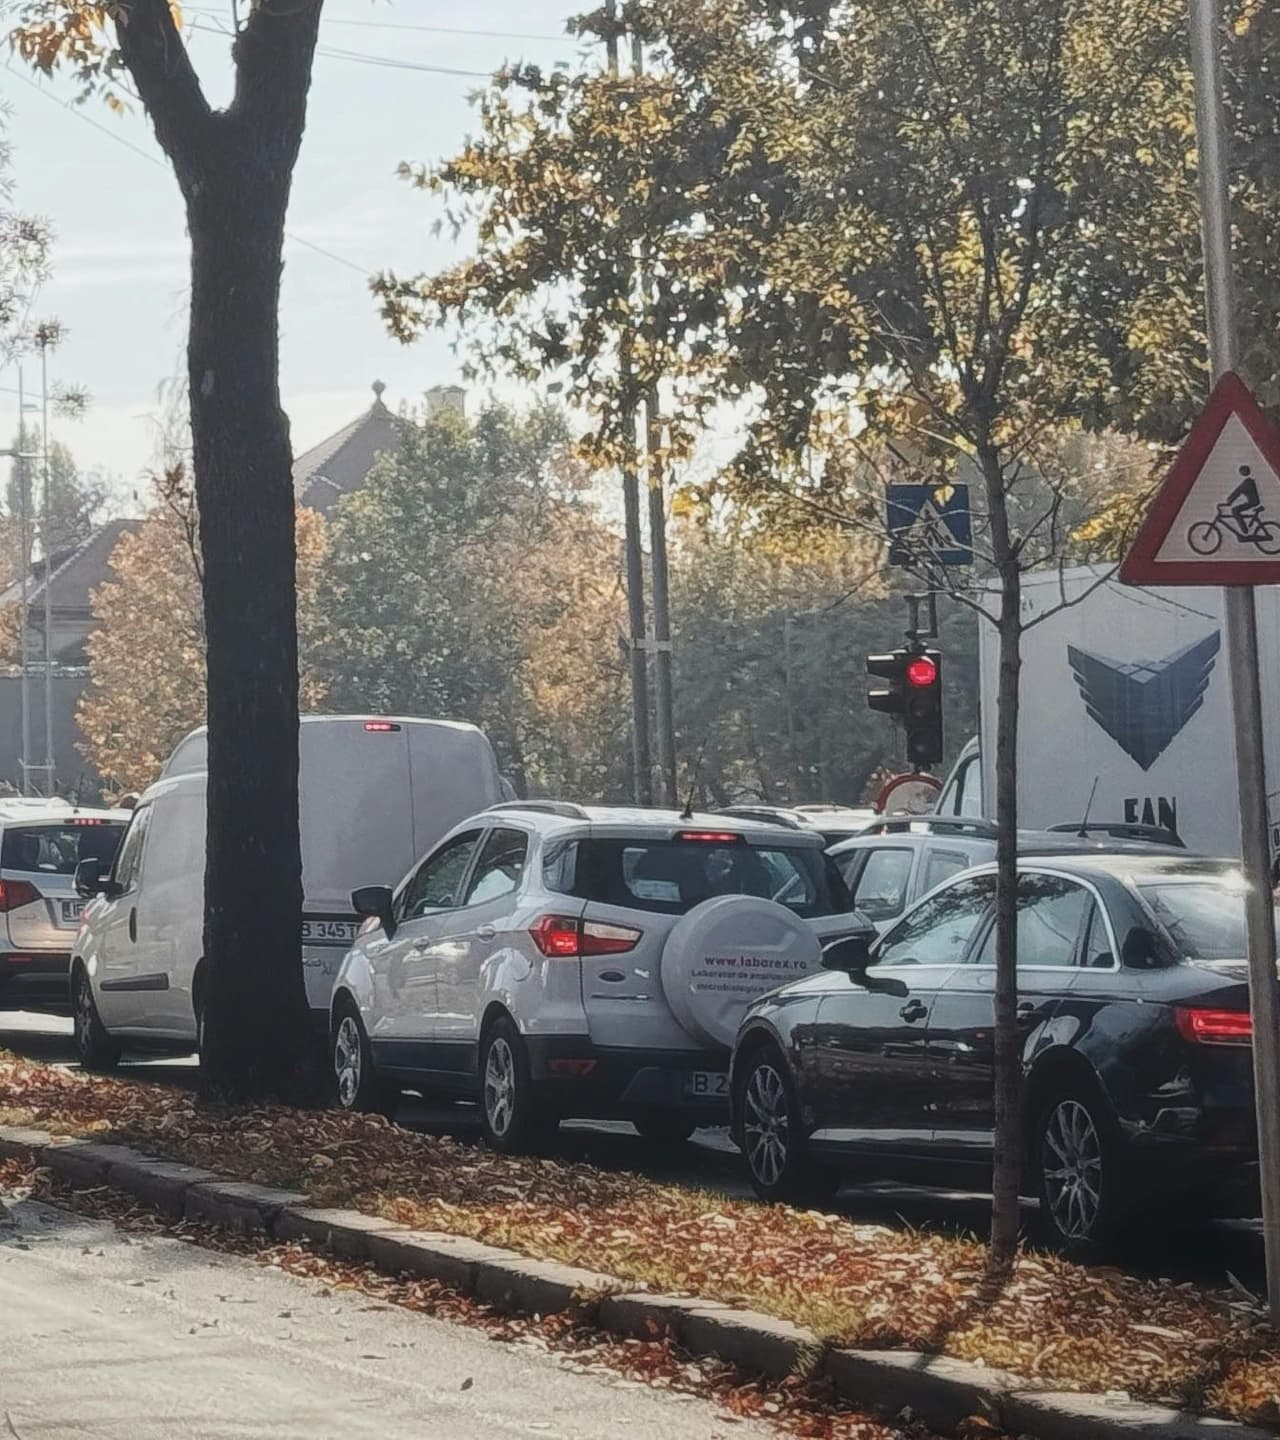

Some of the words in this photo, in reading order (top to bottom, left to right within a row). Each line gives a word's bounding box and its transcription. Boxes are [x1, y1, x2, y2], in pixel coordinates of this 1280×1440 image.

[704, 955, 808, 970] www.laborex.ro
[695, 1073, 708, 1093] B
[715, 1074, 729, 1094] 2
